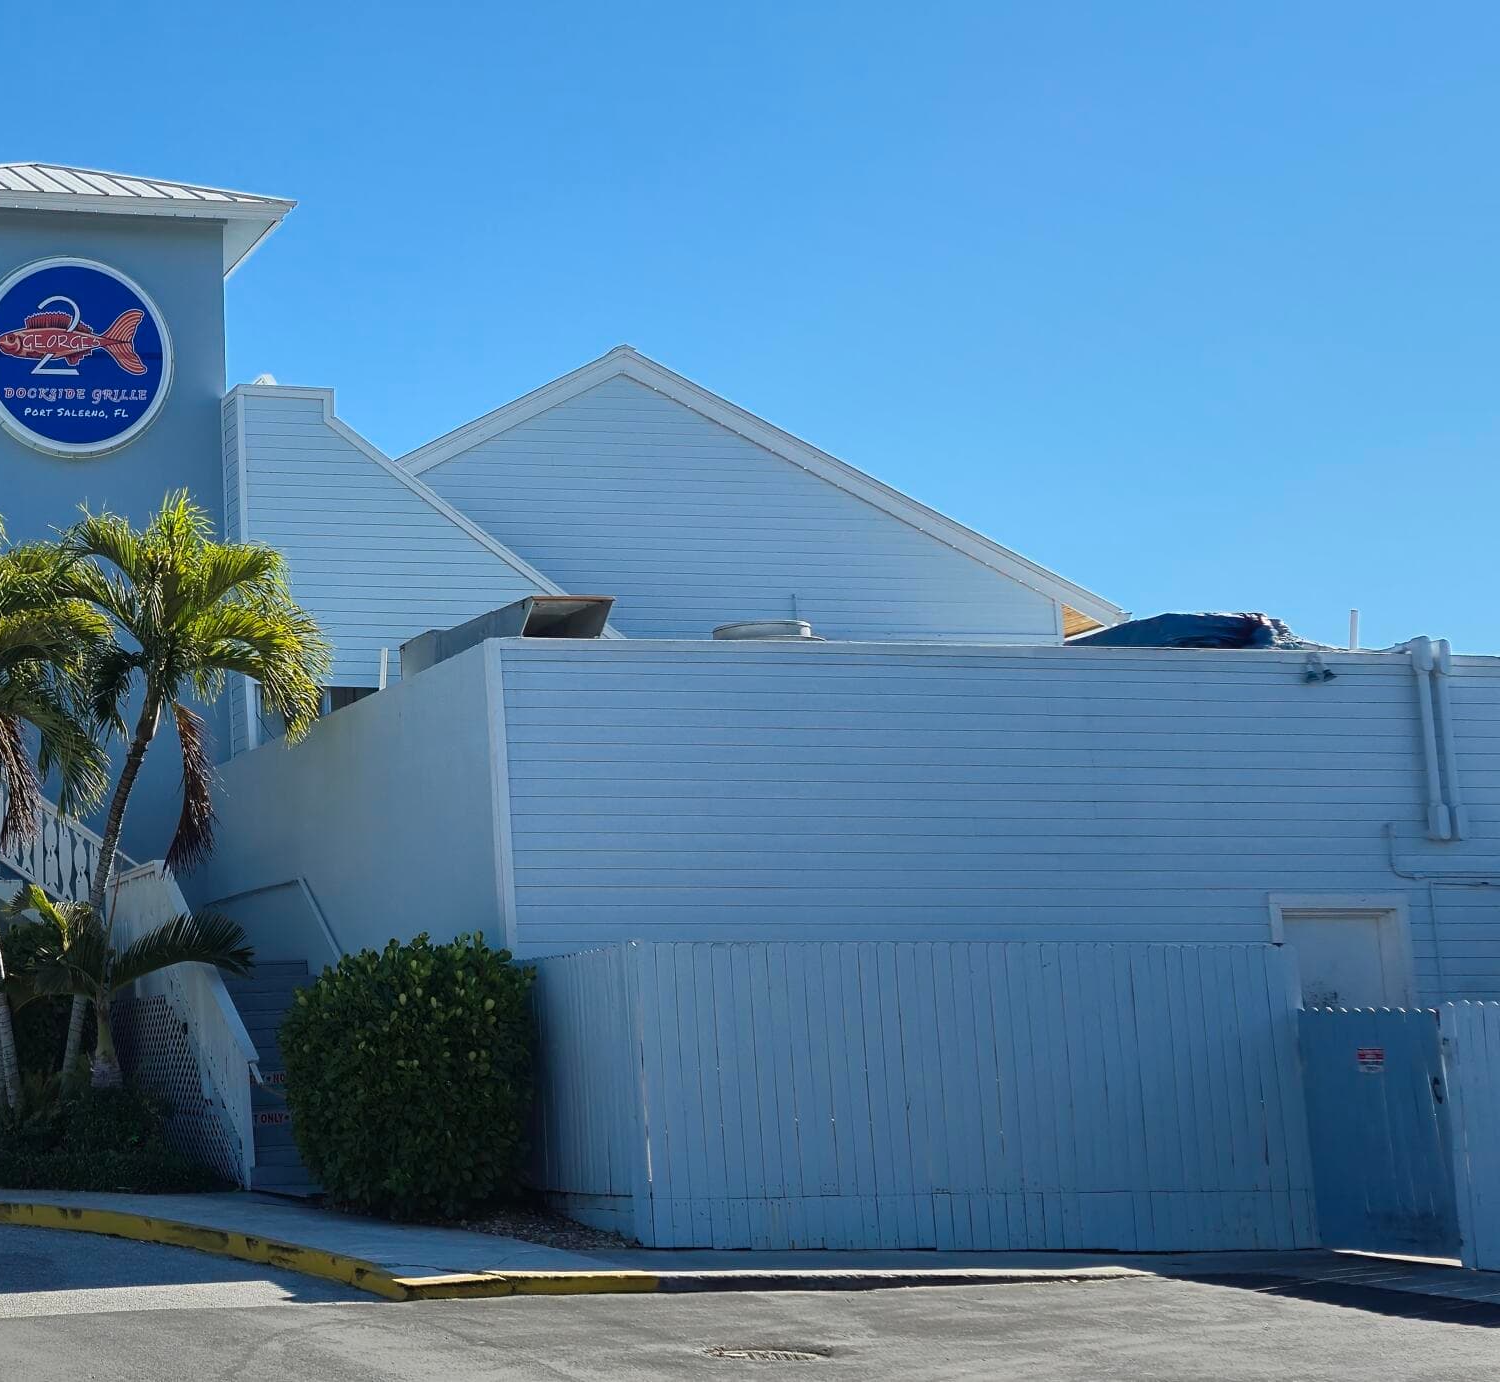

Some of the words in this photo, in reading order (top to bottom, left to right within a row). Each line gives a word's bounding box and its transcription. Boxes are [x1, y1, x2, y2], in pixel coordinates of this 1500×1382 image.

[4, 387, 86, 402] DOCKSIDE
[91, 388, 148, 404] GRILLE
[114, 408, 129, 418] FL
[261, 1114, 284, 1123] ONLY
